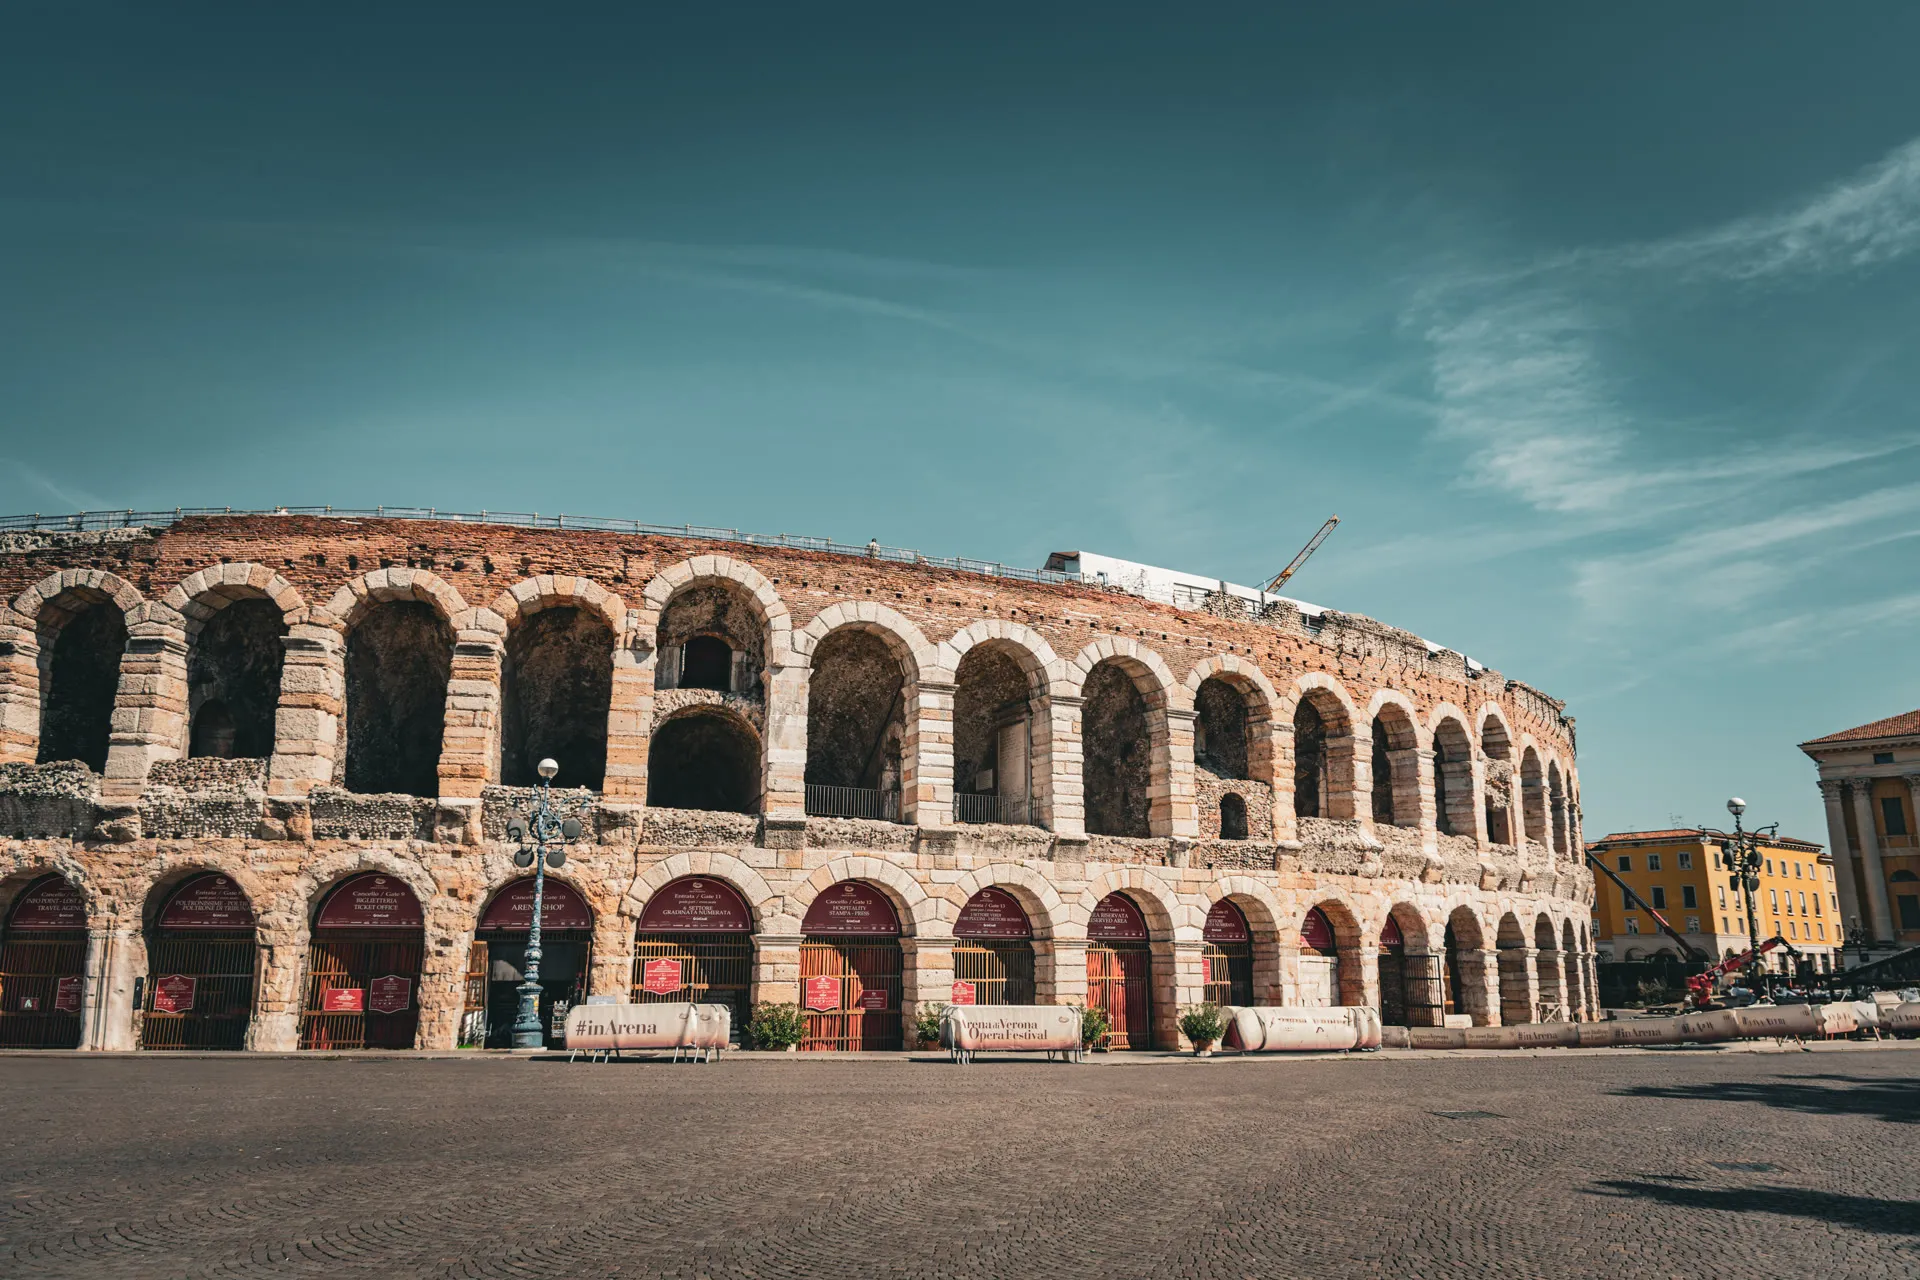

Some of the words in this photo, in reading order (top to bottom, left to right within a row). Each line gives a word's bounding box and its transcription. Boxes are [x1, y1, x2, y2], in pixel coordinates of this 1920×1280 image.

[575, 1019, 657, 1036] #inArena
[962, 1019, 992, 1029] Arena
[1000, 1018, 1038, 1029] Verona
[968, 1027, 1005, 1042] Opera
[1006, 1029, 1048, 1040] Festival
[1518, 1031, 1558, 1040] #inArena
[1615, 1026, 1662, 1038] #inArena
